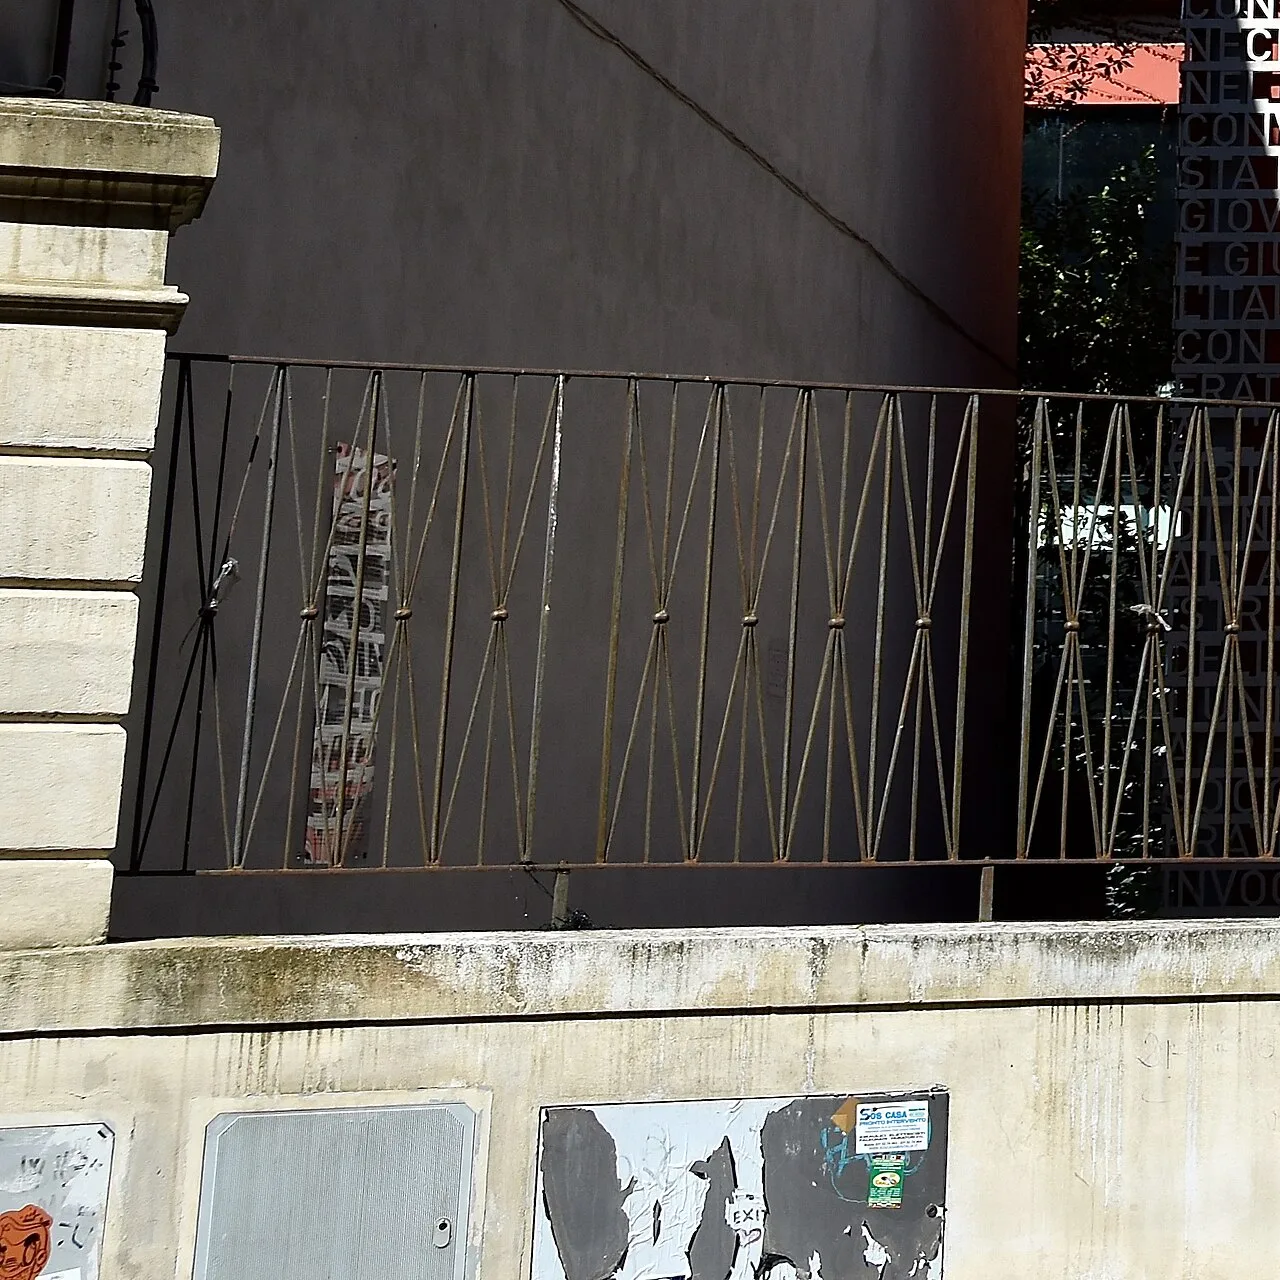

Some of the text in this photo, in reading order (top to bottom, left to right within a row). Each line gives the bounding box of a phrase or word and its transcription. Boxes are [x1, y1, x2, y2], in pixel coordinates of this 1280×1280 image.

[1185, 70, 1268, 104] NEL
[1182, 155, 1258, 190] STA
[886, 1111, 907, 1119] CASA
